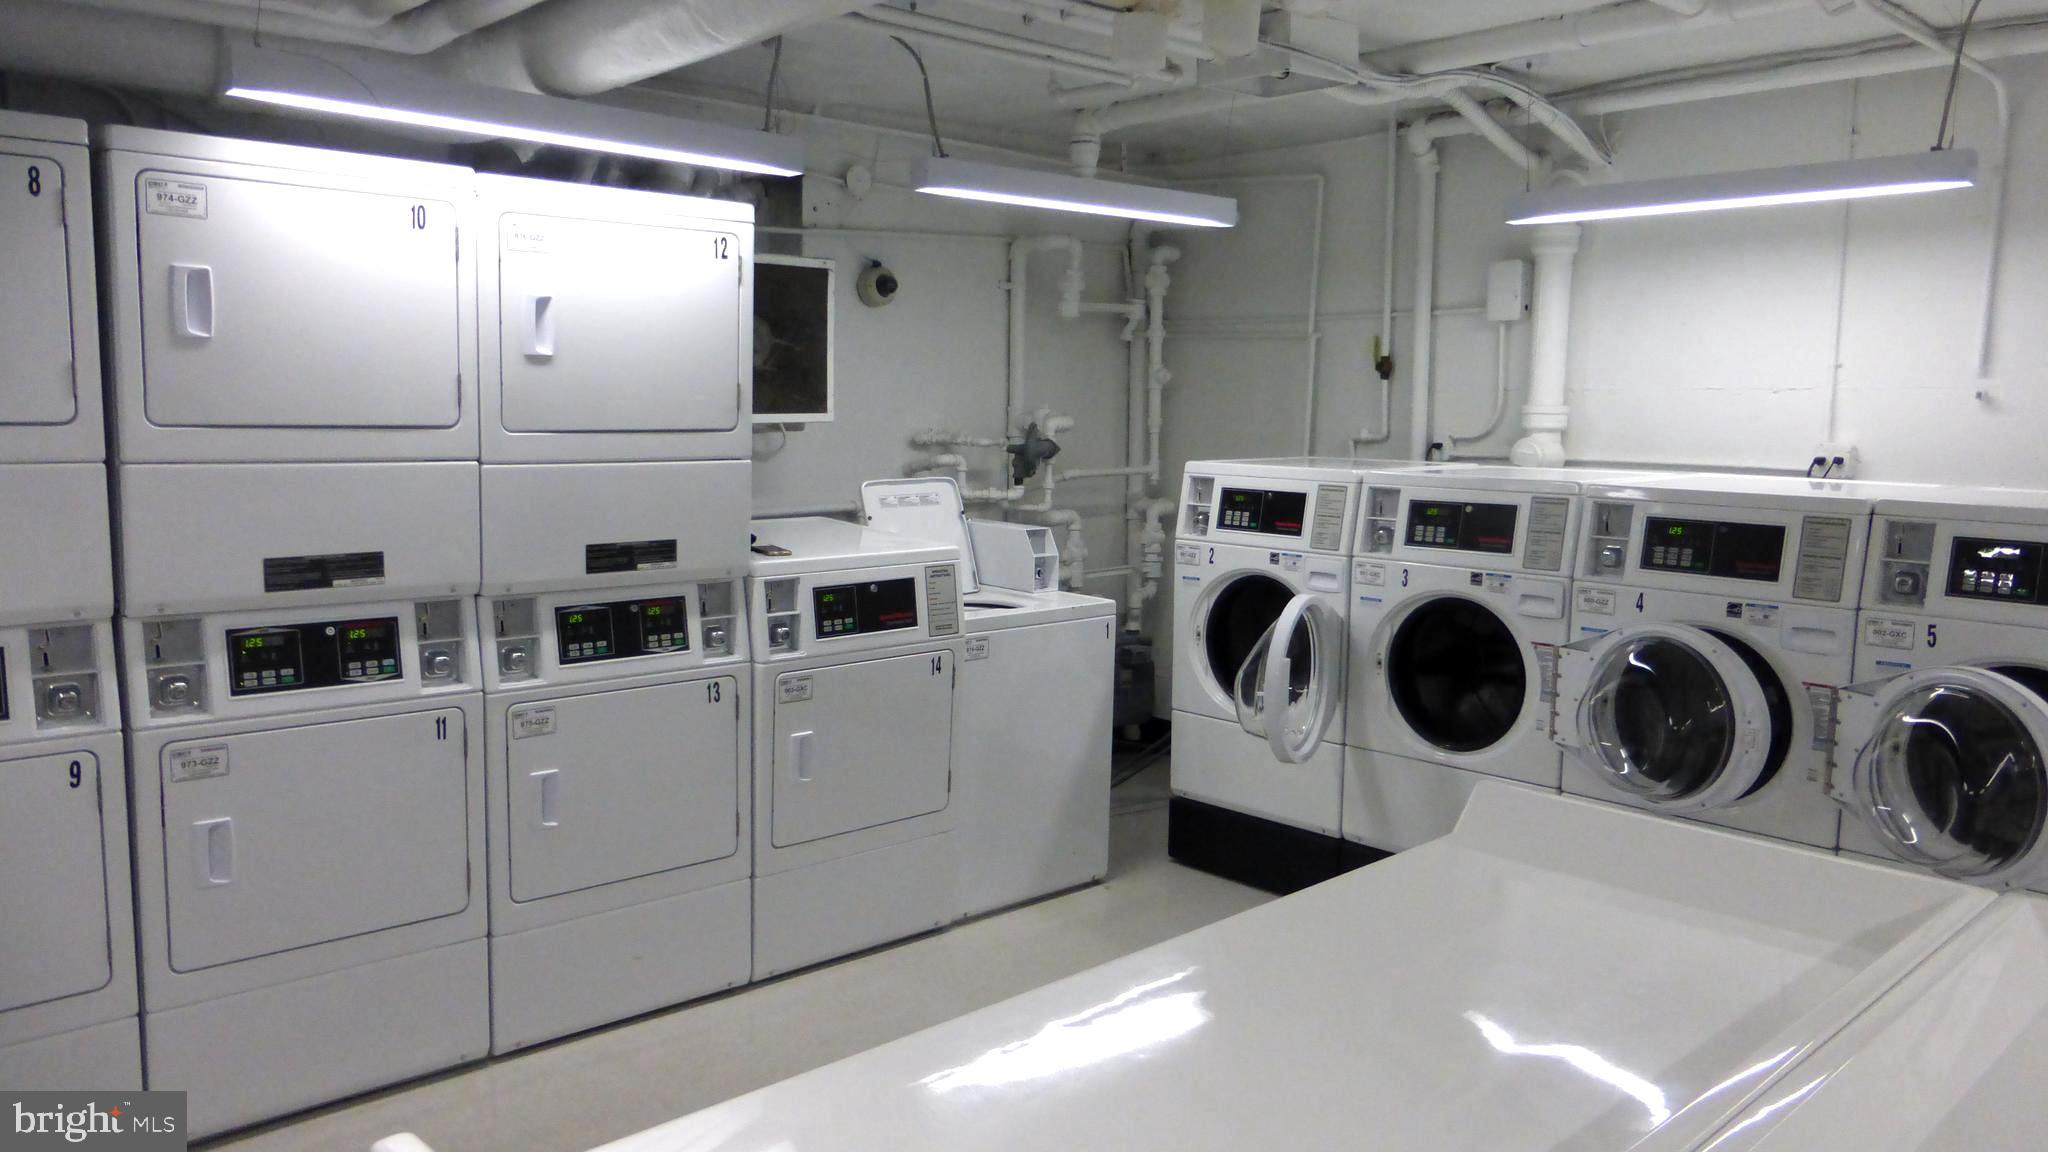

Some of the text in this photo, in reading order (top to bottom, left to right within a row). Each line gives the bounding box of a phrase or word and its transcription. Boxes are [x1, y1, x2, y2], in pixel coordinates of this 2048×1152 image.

[27, 165, 41, 197] 8
[411, 204, 426, 230] 10
[713, 236, 728, 260] 12
[1208, 547, 1215, 565] 2
[1401, 568, 1409, 588] 3
[1635, 592, 1644, 613] 4
[1927, 624, 1937, 648] 5
[930, 655, 942, 677] 14
[706, 682, 721, 705] 13
[435, 716, 447, 741] 11
[69, 760, 82, 789] 9
